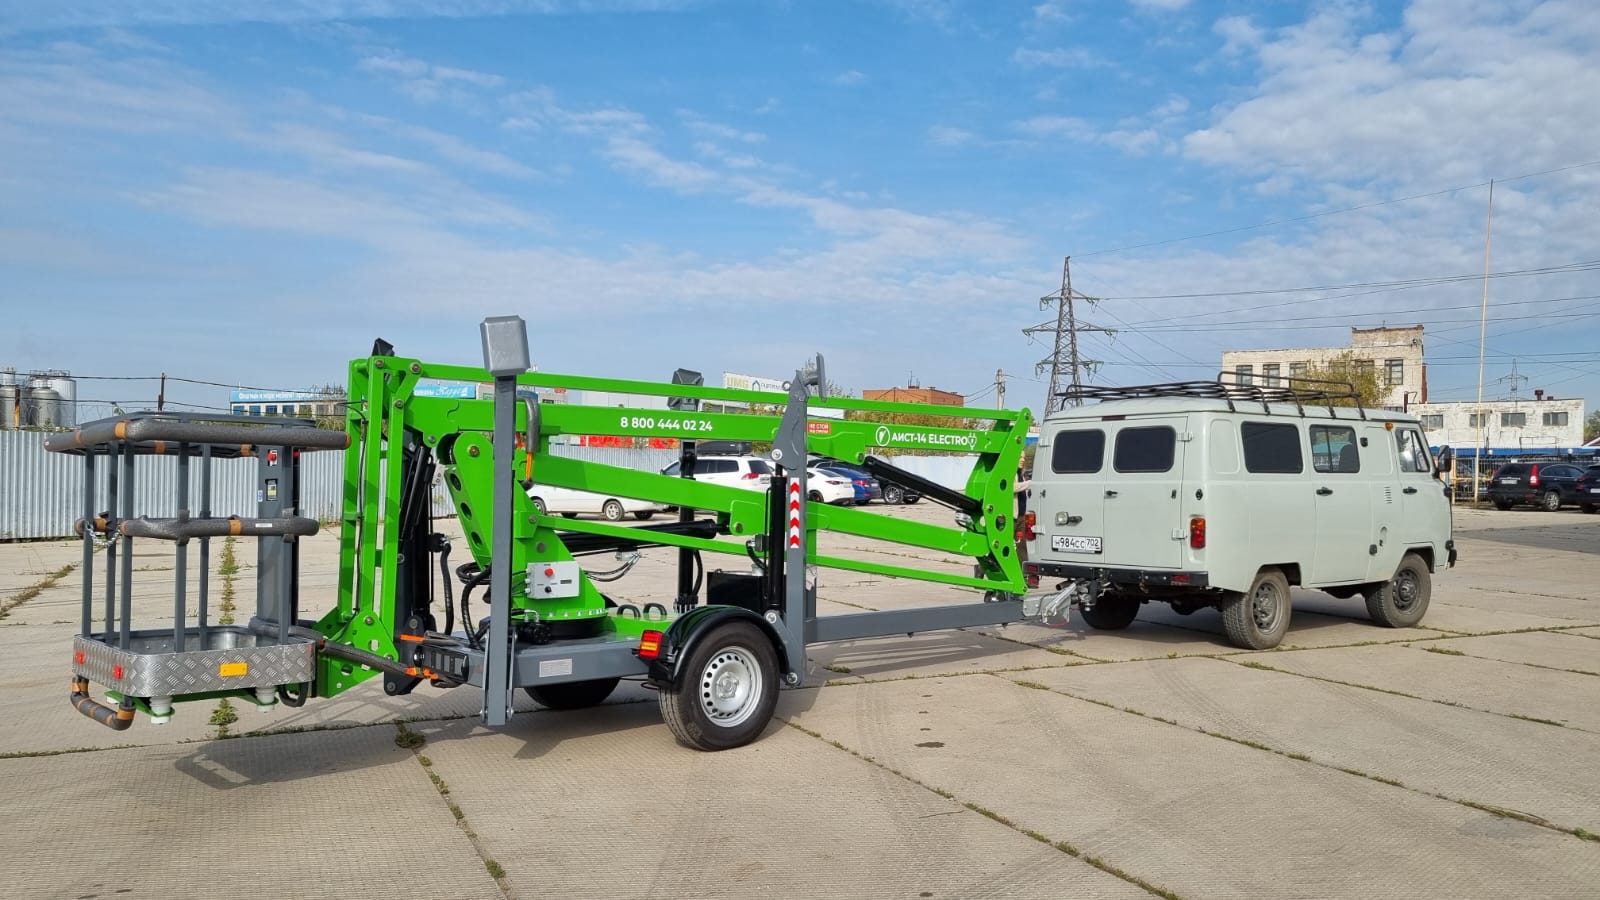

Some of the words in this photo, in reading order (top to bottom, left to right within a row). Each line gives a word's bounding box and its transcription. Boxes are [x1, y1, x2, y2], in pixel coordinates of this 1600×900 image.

[620, 416, 629, 428] 8
[631, 417, 654, 429] 800
[657, 418, 680, 430] 444
[682, 419, 697, 431] 02
[698, 420, 713, 431] 24
[891, 432, 926, 443] АИСТ-14
[928, 434, 968, 446] ELECTRO
